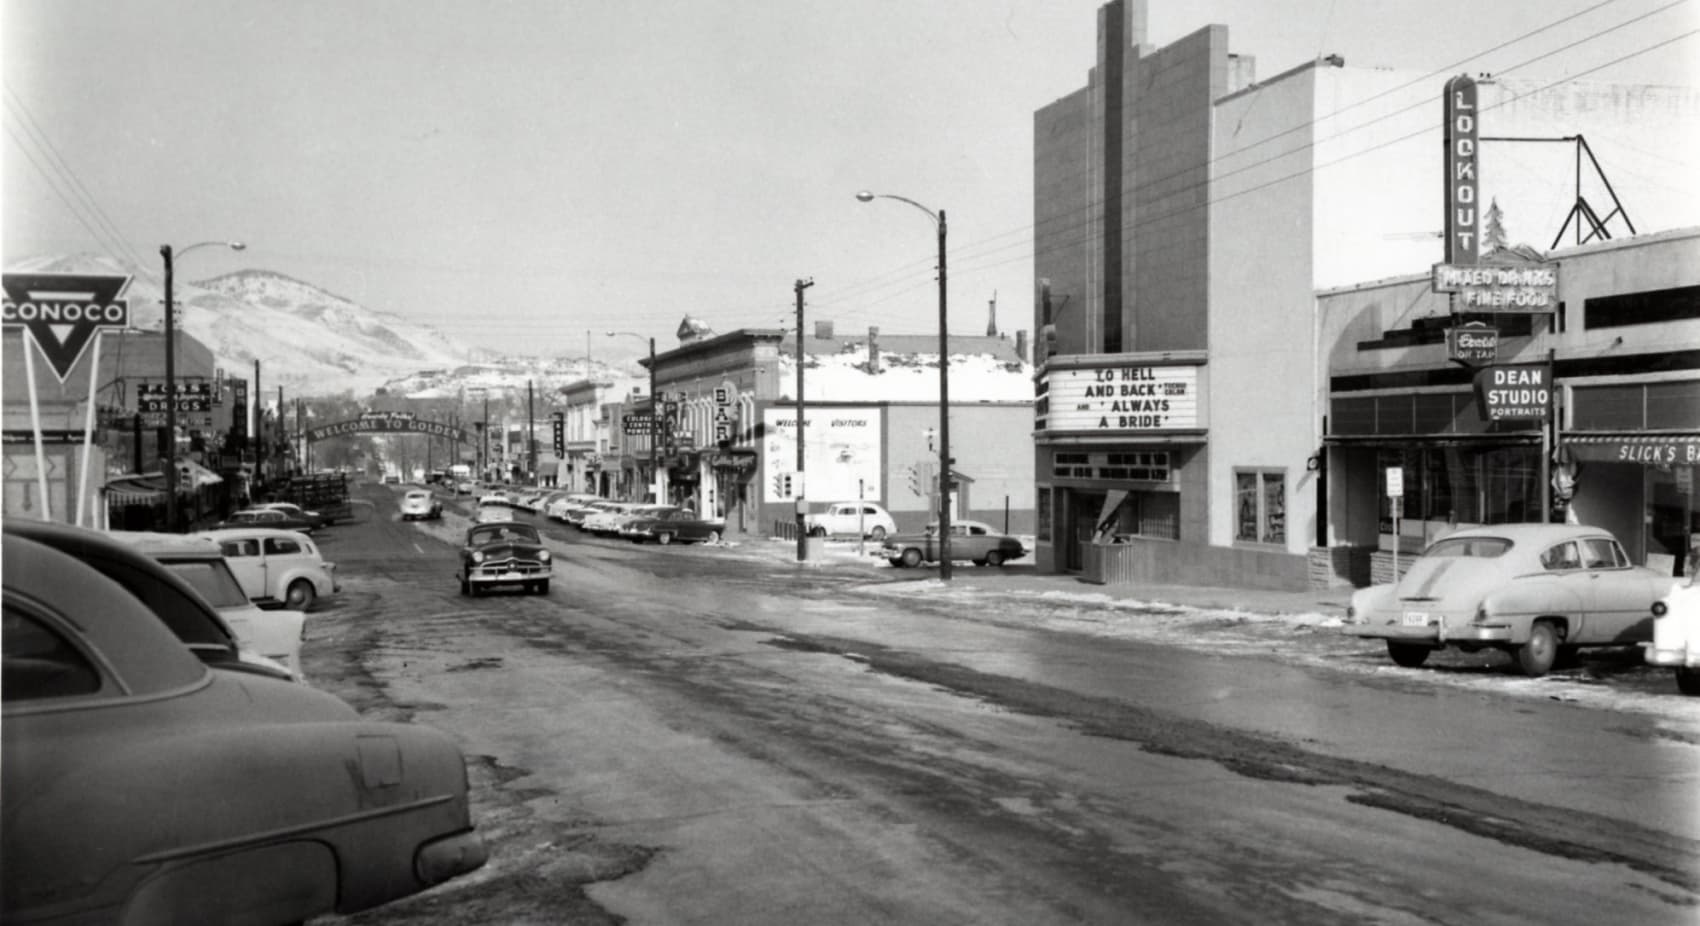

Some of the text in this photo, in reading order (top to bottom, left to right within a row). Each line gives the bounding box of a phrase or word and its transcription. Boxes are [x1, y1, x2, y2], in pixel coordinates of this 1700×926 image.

[1456, 91, 1474, 250] LOOKOUT
[1444, 269, 1554, 286] MIXED DRINKS
[1466, 291, 1548, 306] FINE FOOD
[3, 302, 123, 321] CONOCO
[1095, 367, 1156, 382] TO HELL
[1495, 370, 1542, 385] DEAN
[1085, 385, 1114, 397] AND
[1488, 390, 1548, 405] STUDIO
[1112, 399, 1170, 412] ALWAYS
[1490, 407, 1546, 417] PORTRAITS
[715, 389, 728, 440] BAR
[1099, 416, 1109, 428] A
[313, 419, 461, 439] WELCOME TO GOLDEN
[1618, 444, 1677, 462] SLICK'S
